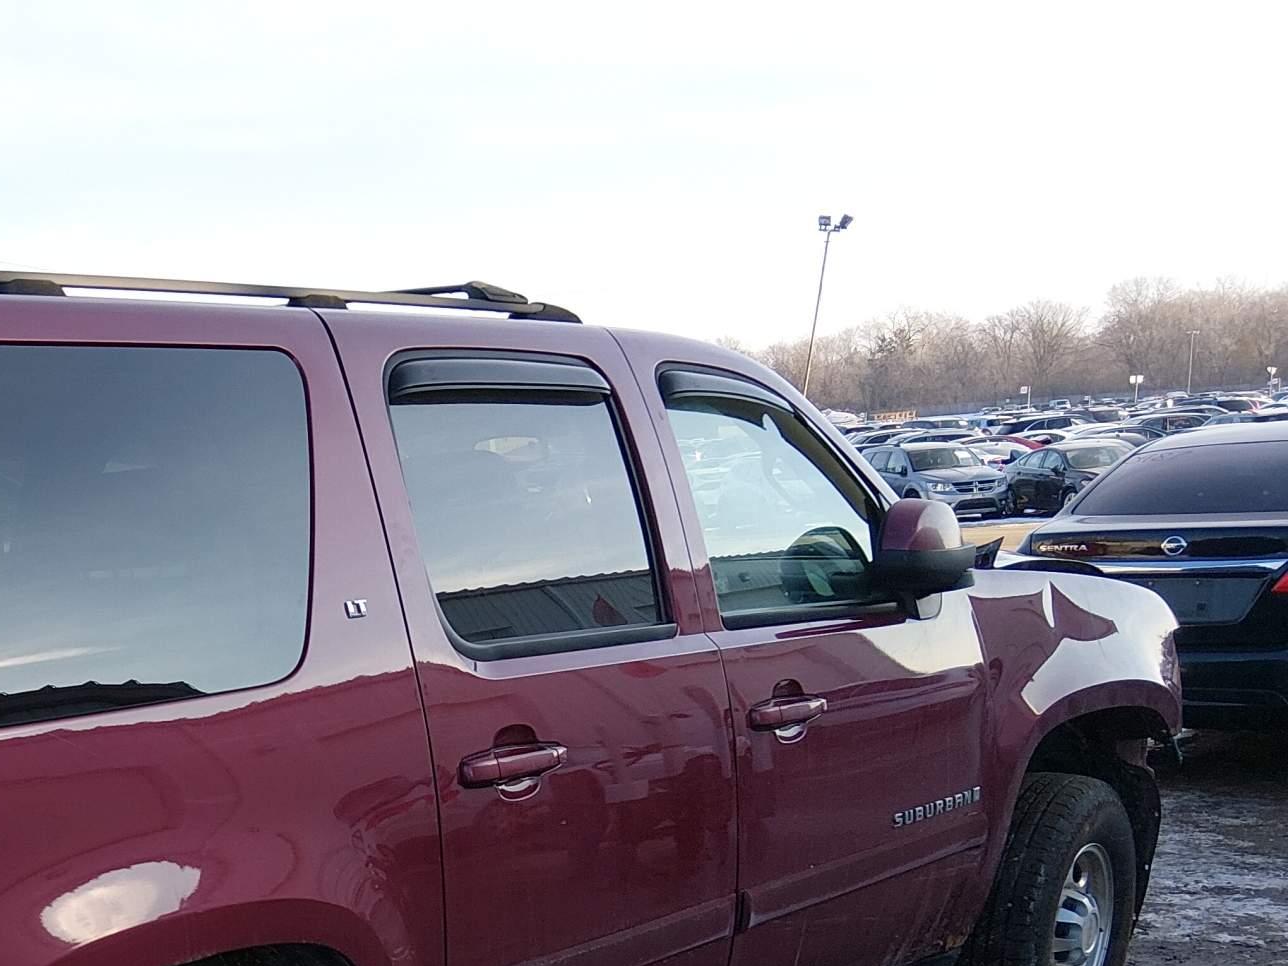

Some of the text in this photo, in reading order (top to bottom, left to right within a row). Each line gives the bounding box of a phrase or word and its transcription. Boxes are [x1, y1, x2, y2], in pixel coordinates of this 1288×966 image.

[1039, 544, 1089, 552] SENTRA
[344, 599, 367, 619] LT
[893, 789, 972, 828] SUBURBAN
